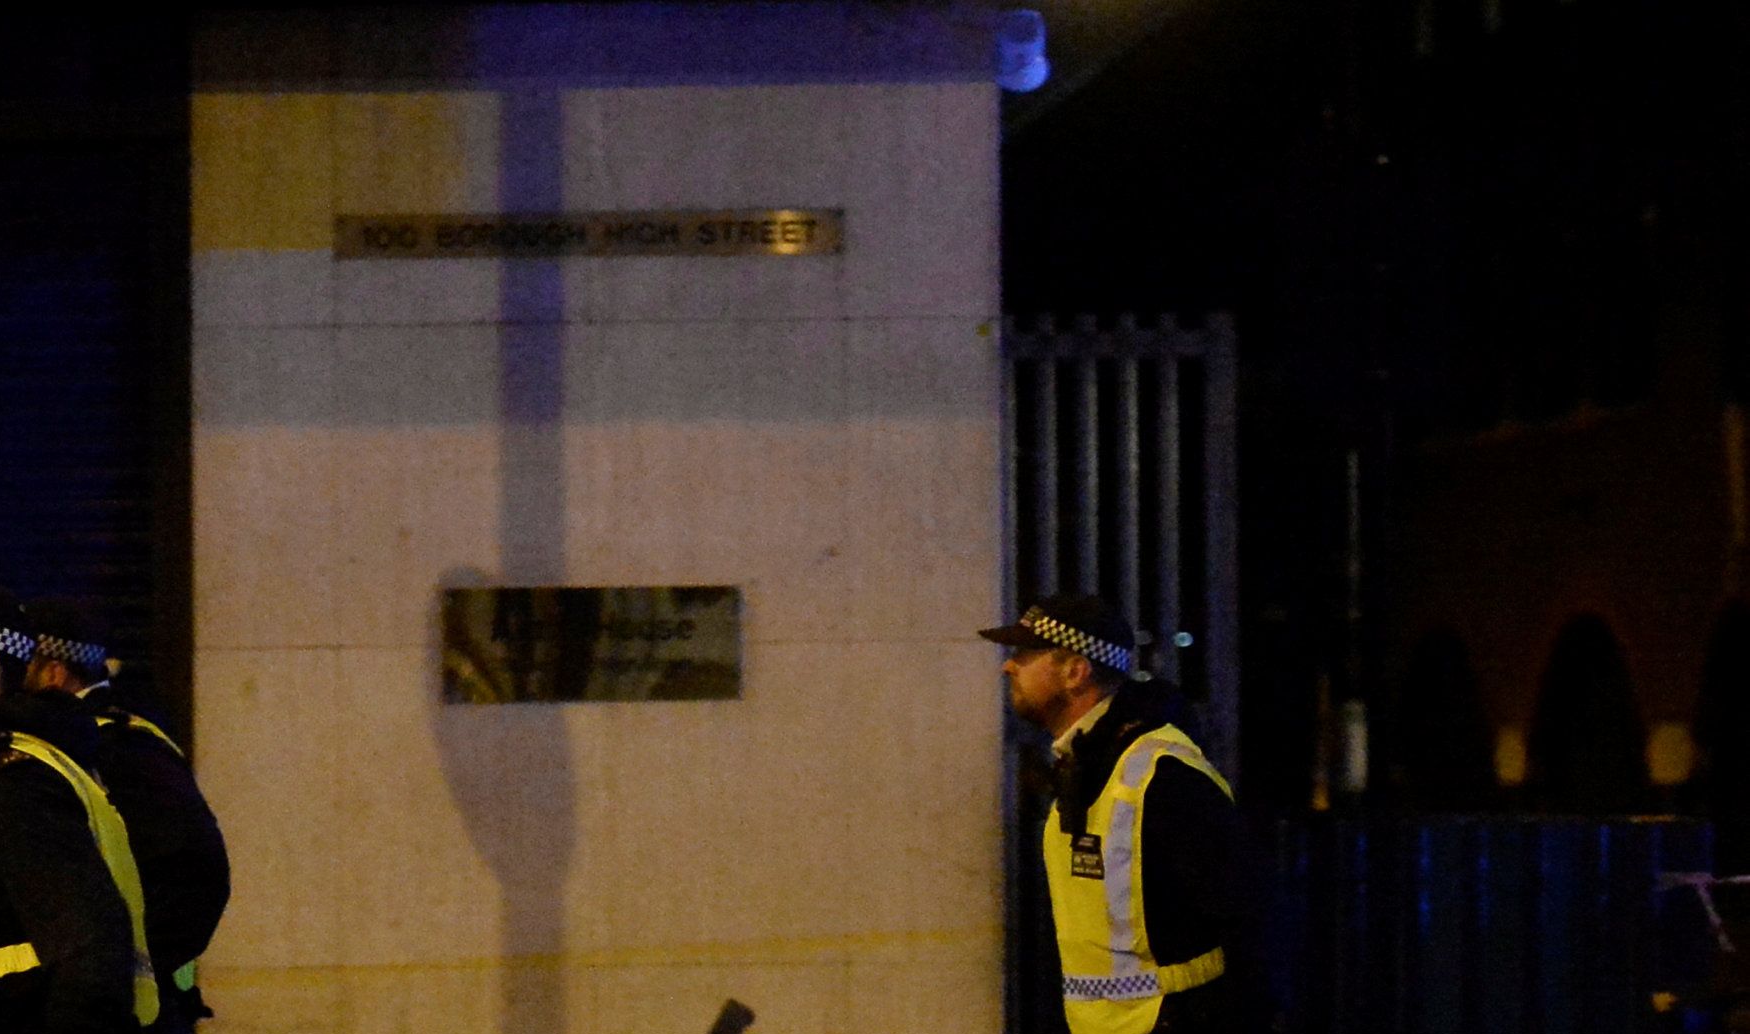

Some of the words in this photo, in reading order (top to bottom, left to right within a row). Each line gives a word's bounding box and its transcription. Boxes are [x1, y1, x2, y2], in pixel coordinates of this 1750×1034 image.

[362, 223, 419, 249] 100
[436, 221, 586, 249] BOROUGH
[604, 220, 680, 246] HIGH
[697, 218, 817, 246] STREET
